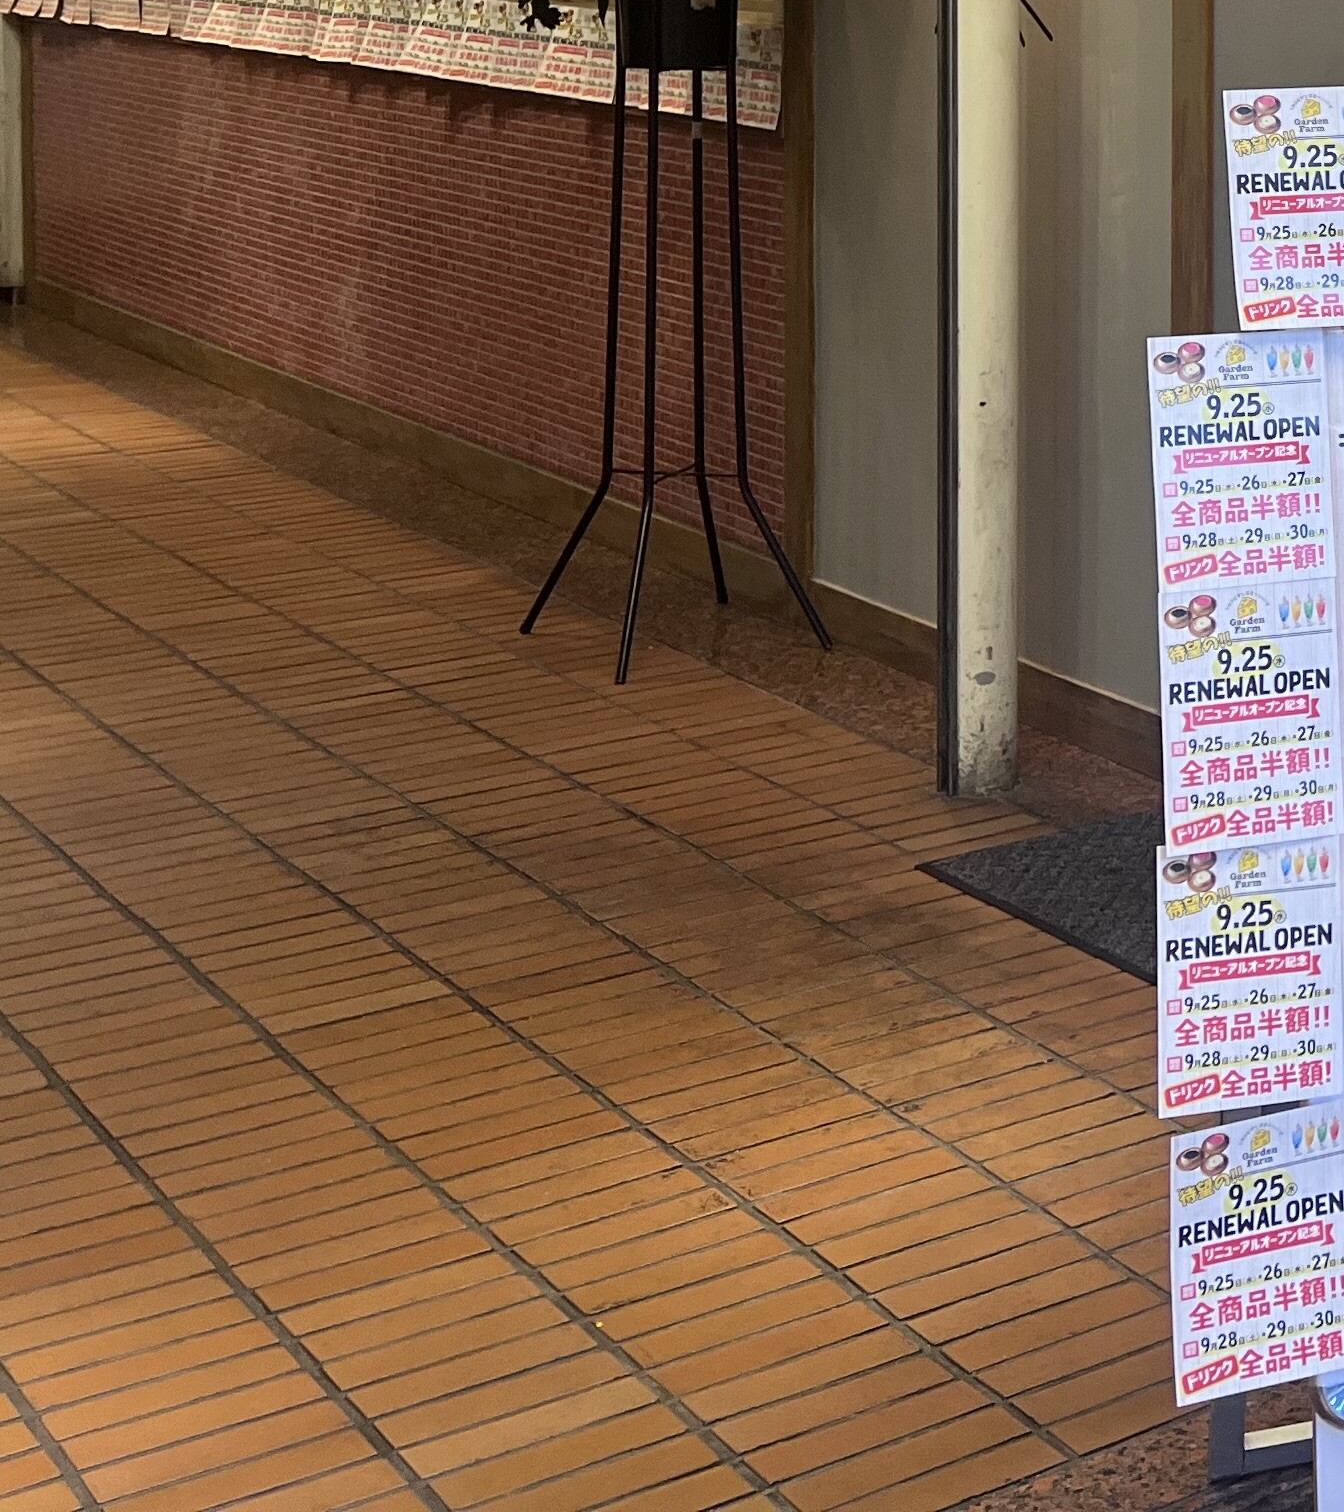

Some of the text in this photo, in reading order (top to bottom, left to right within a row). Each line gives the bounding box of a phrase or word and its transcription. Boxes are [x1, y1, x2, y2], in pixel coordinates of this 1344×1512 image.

[1283, 145, 1337, 169] 9.25
[1237, 171, 1337, 194] RENEWAL
[1249, 299, 1291, 320] ドリンク
[1206, 392, 1262, 420] 9.25
[1159, 416, 1320, 448] RENEWAL OPEN
[1185, 445, 1297, 465] リニューアルオープン記念
[1171, 493, 1321, 528] 全商品半額!!
[1168, 544, 1325, 582] ドリンク 全品半額!
[1217, 645, 1272, 674] 9.25
[1169, 668, 1330, 705] RENEWAL OPEN
[1193, 700, 1307, 722] リニューアルオープン記念
[1179, 747, 1330, 788] 全商品半額!!
[1175, 800, 1334, 843] ドリンク 全品半額!
[1216, 900, 1273, 930] 9.25
[1165, 923, 1333, 963] RENEWAL OPEN
[1191, 956, 1309, 980] リニューアルオープン記念
[1174, 1005, 1330, 1048] 全商品半額!!
[1168, 1060, 1331, 1104] ドリンク 全品半額!
[1228, 1174, 1284, 1210] 9.25
[1178, 1190, 1344, 1248] RENEWAL OPEN
[1203, 1224, 1321, 1261] リニューアルオープン記念
[1186, 1360, 1234, 1392] ドリンク
